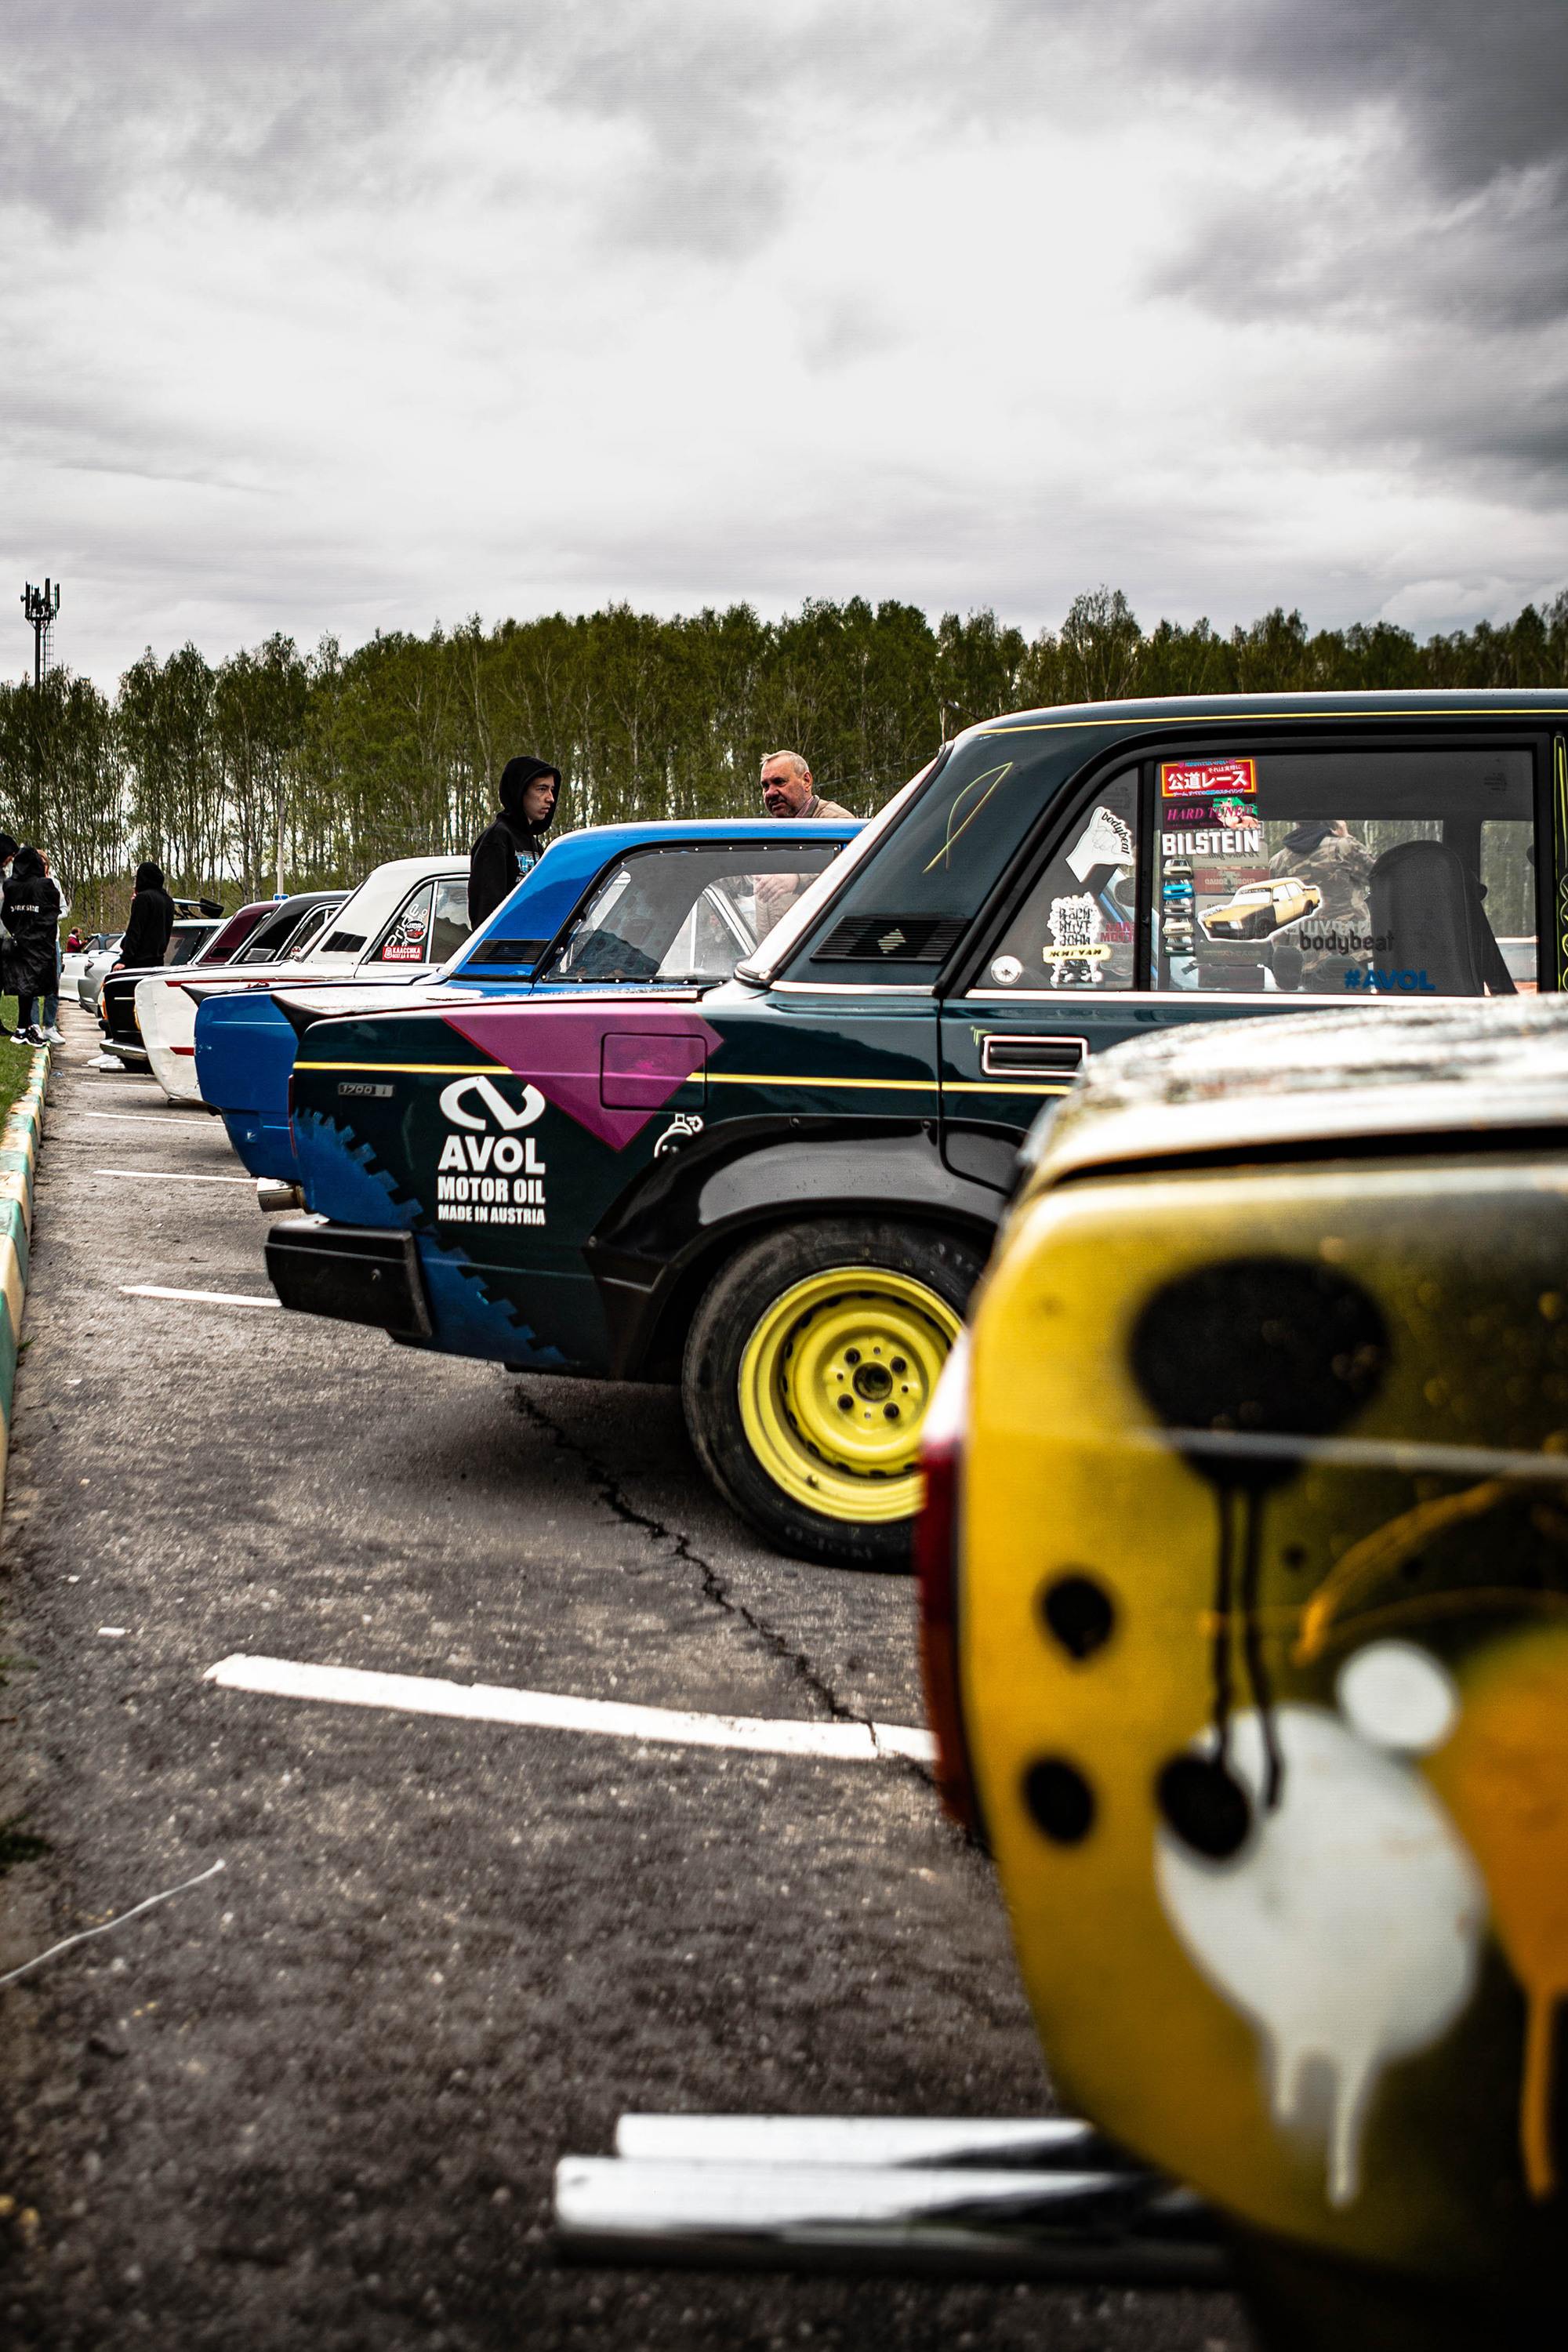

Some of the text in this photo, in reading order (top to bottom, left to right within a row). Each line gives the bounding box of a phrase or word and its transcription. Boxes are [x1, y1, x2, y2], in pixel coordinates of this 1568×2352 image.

[1167, 770, 1247, 790] 公道レース
[1167, 805, 1254, 821] HARD TUNED
[1162, 830, 1259, 855] BILSTEIN
[1299, 929, 1395, 955] bodybeat
[1344, 969, 1436, 990] #AVOL
[437, 1135, 546, 1174] AVOL
[437, 1176, 546, 1204] MOTOR OIL
[437, 1204, 546, 1225] MADE IN AUSTRIA
